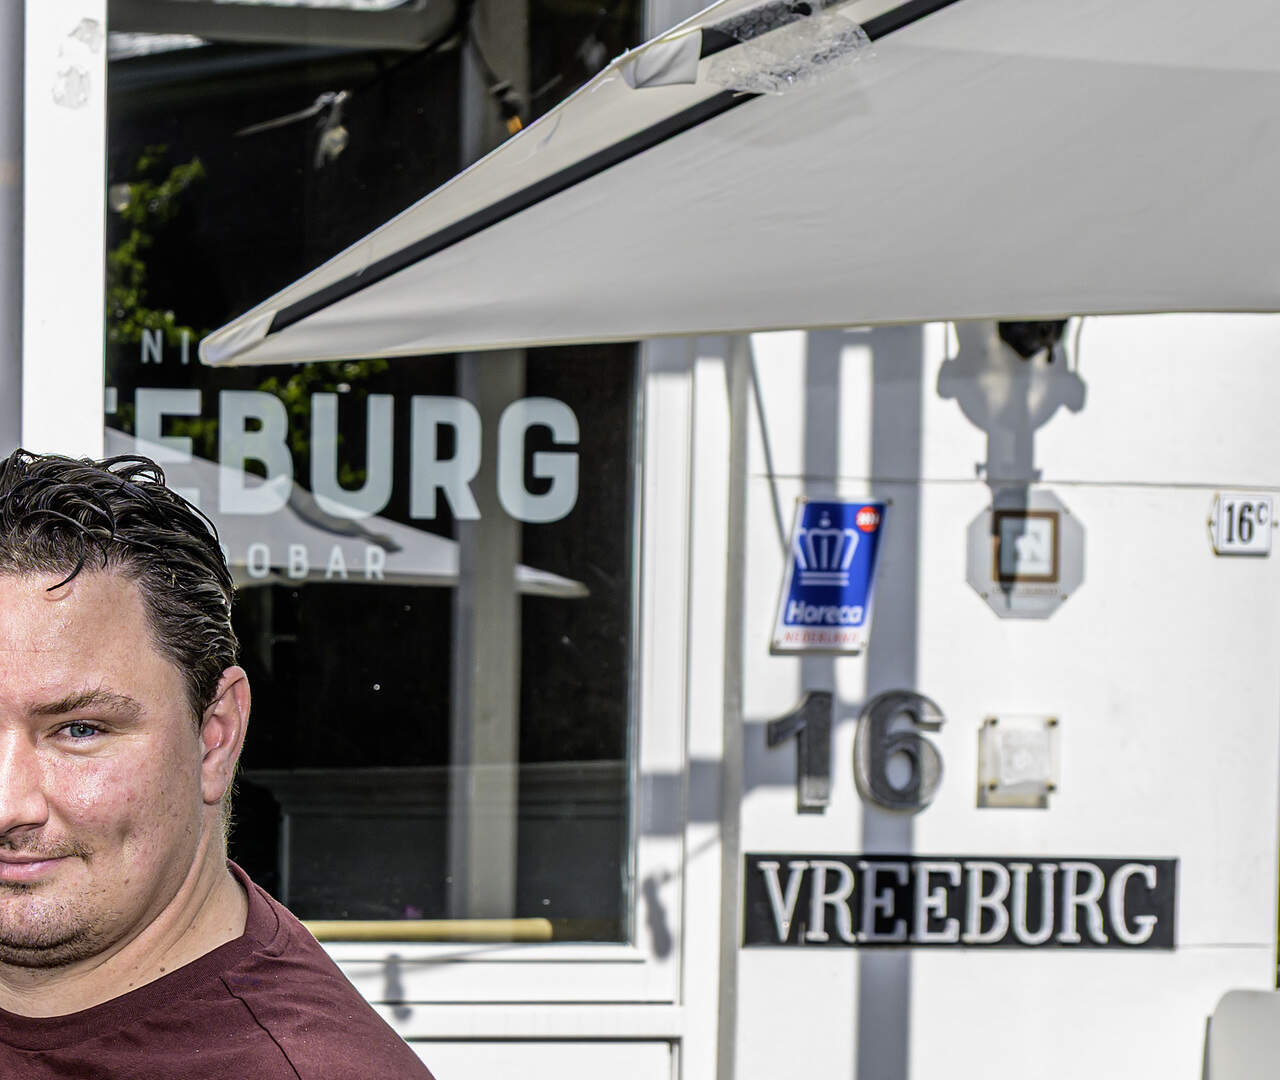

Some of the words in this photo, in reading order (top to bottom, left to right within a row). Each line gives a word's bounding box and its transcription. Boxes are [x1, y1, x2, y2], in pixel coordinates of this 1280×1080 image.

[786, 599, 864, 624] Horeca
[766, 689, 946, 815] 16
[756, 860, 1158, 945] VREEBURG
